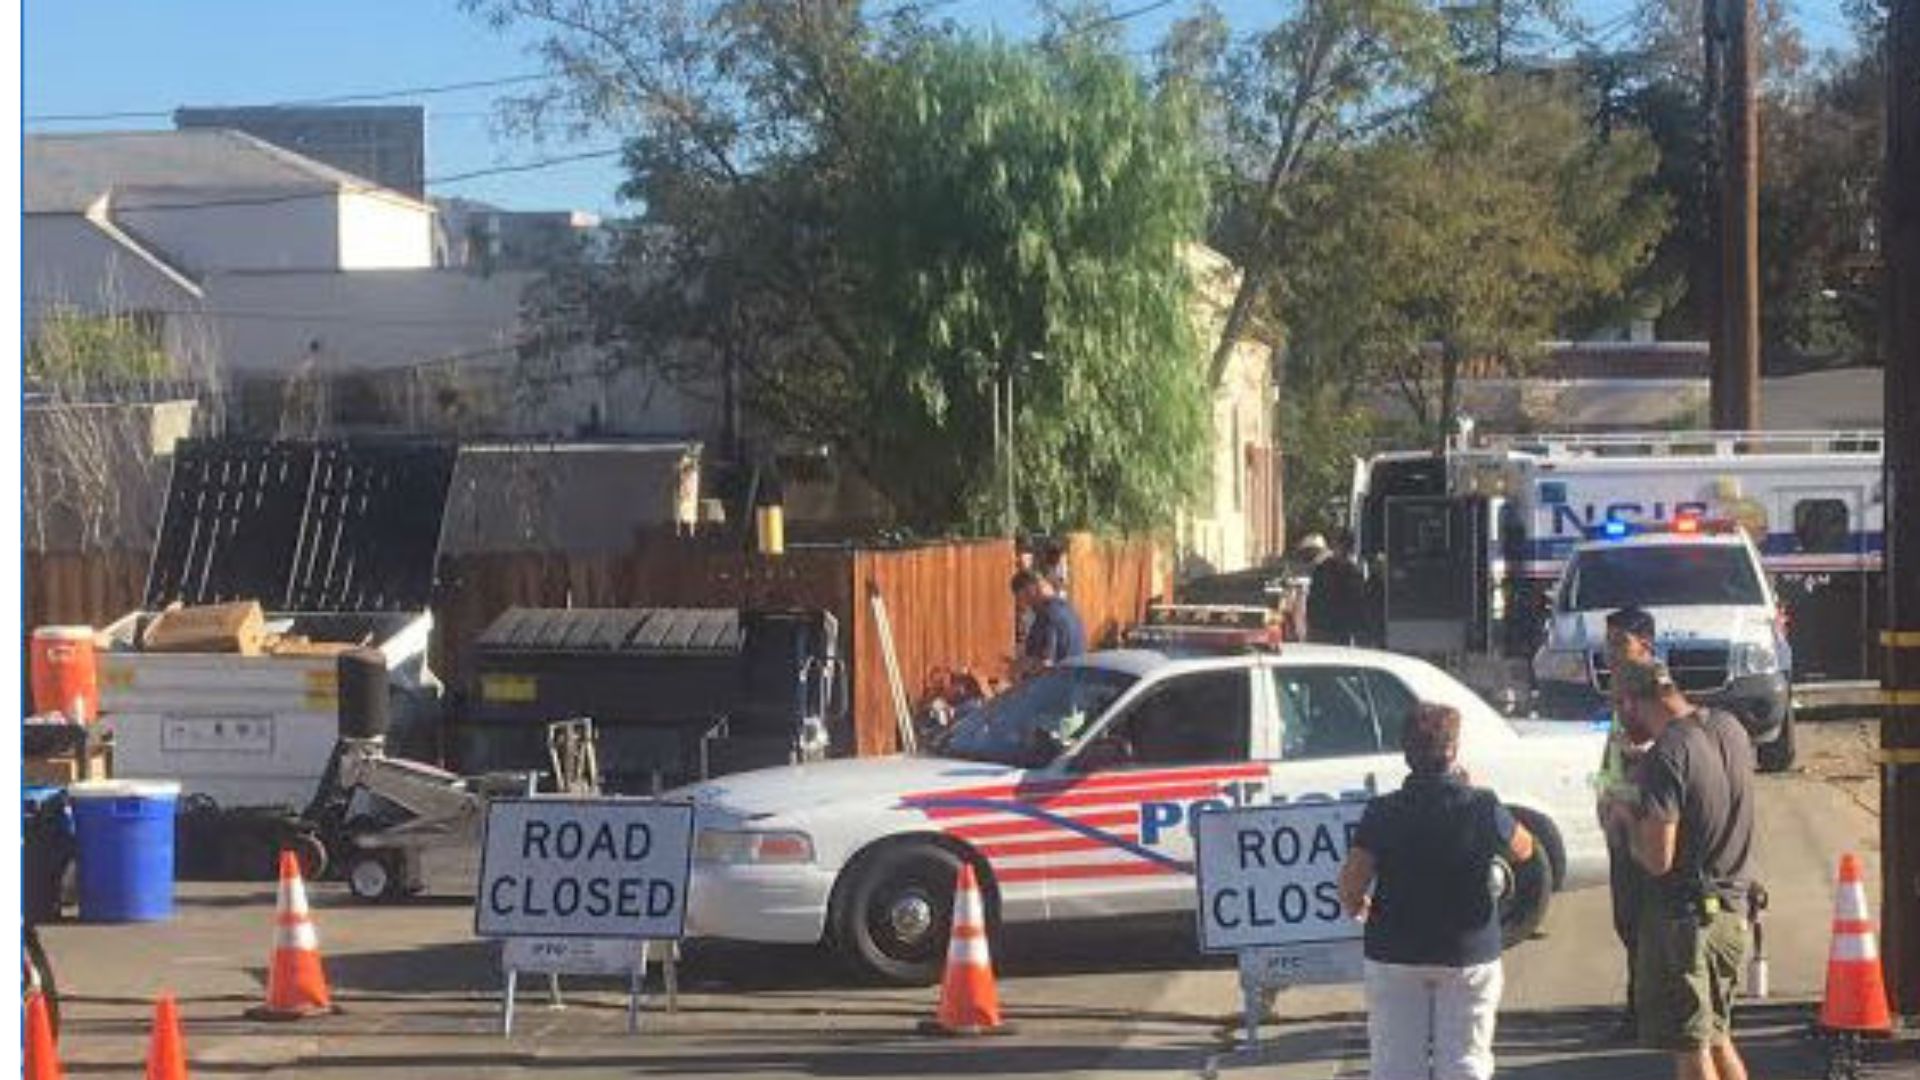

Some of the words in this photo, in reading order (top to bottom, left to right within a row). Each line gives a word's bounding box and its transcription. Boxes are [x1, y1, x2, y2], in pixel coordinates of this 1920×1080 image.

[523, 820, 652, 861] ROAD
[491, 875, 675, 916] CLOSED
[1213, 882, 1341, 928] CLOS
